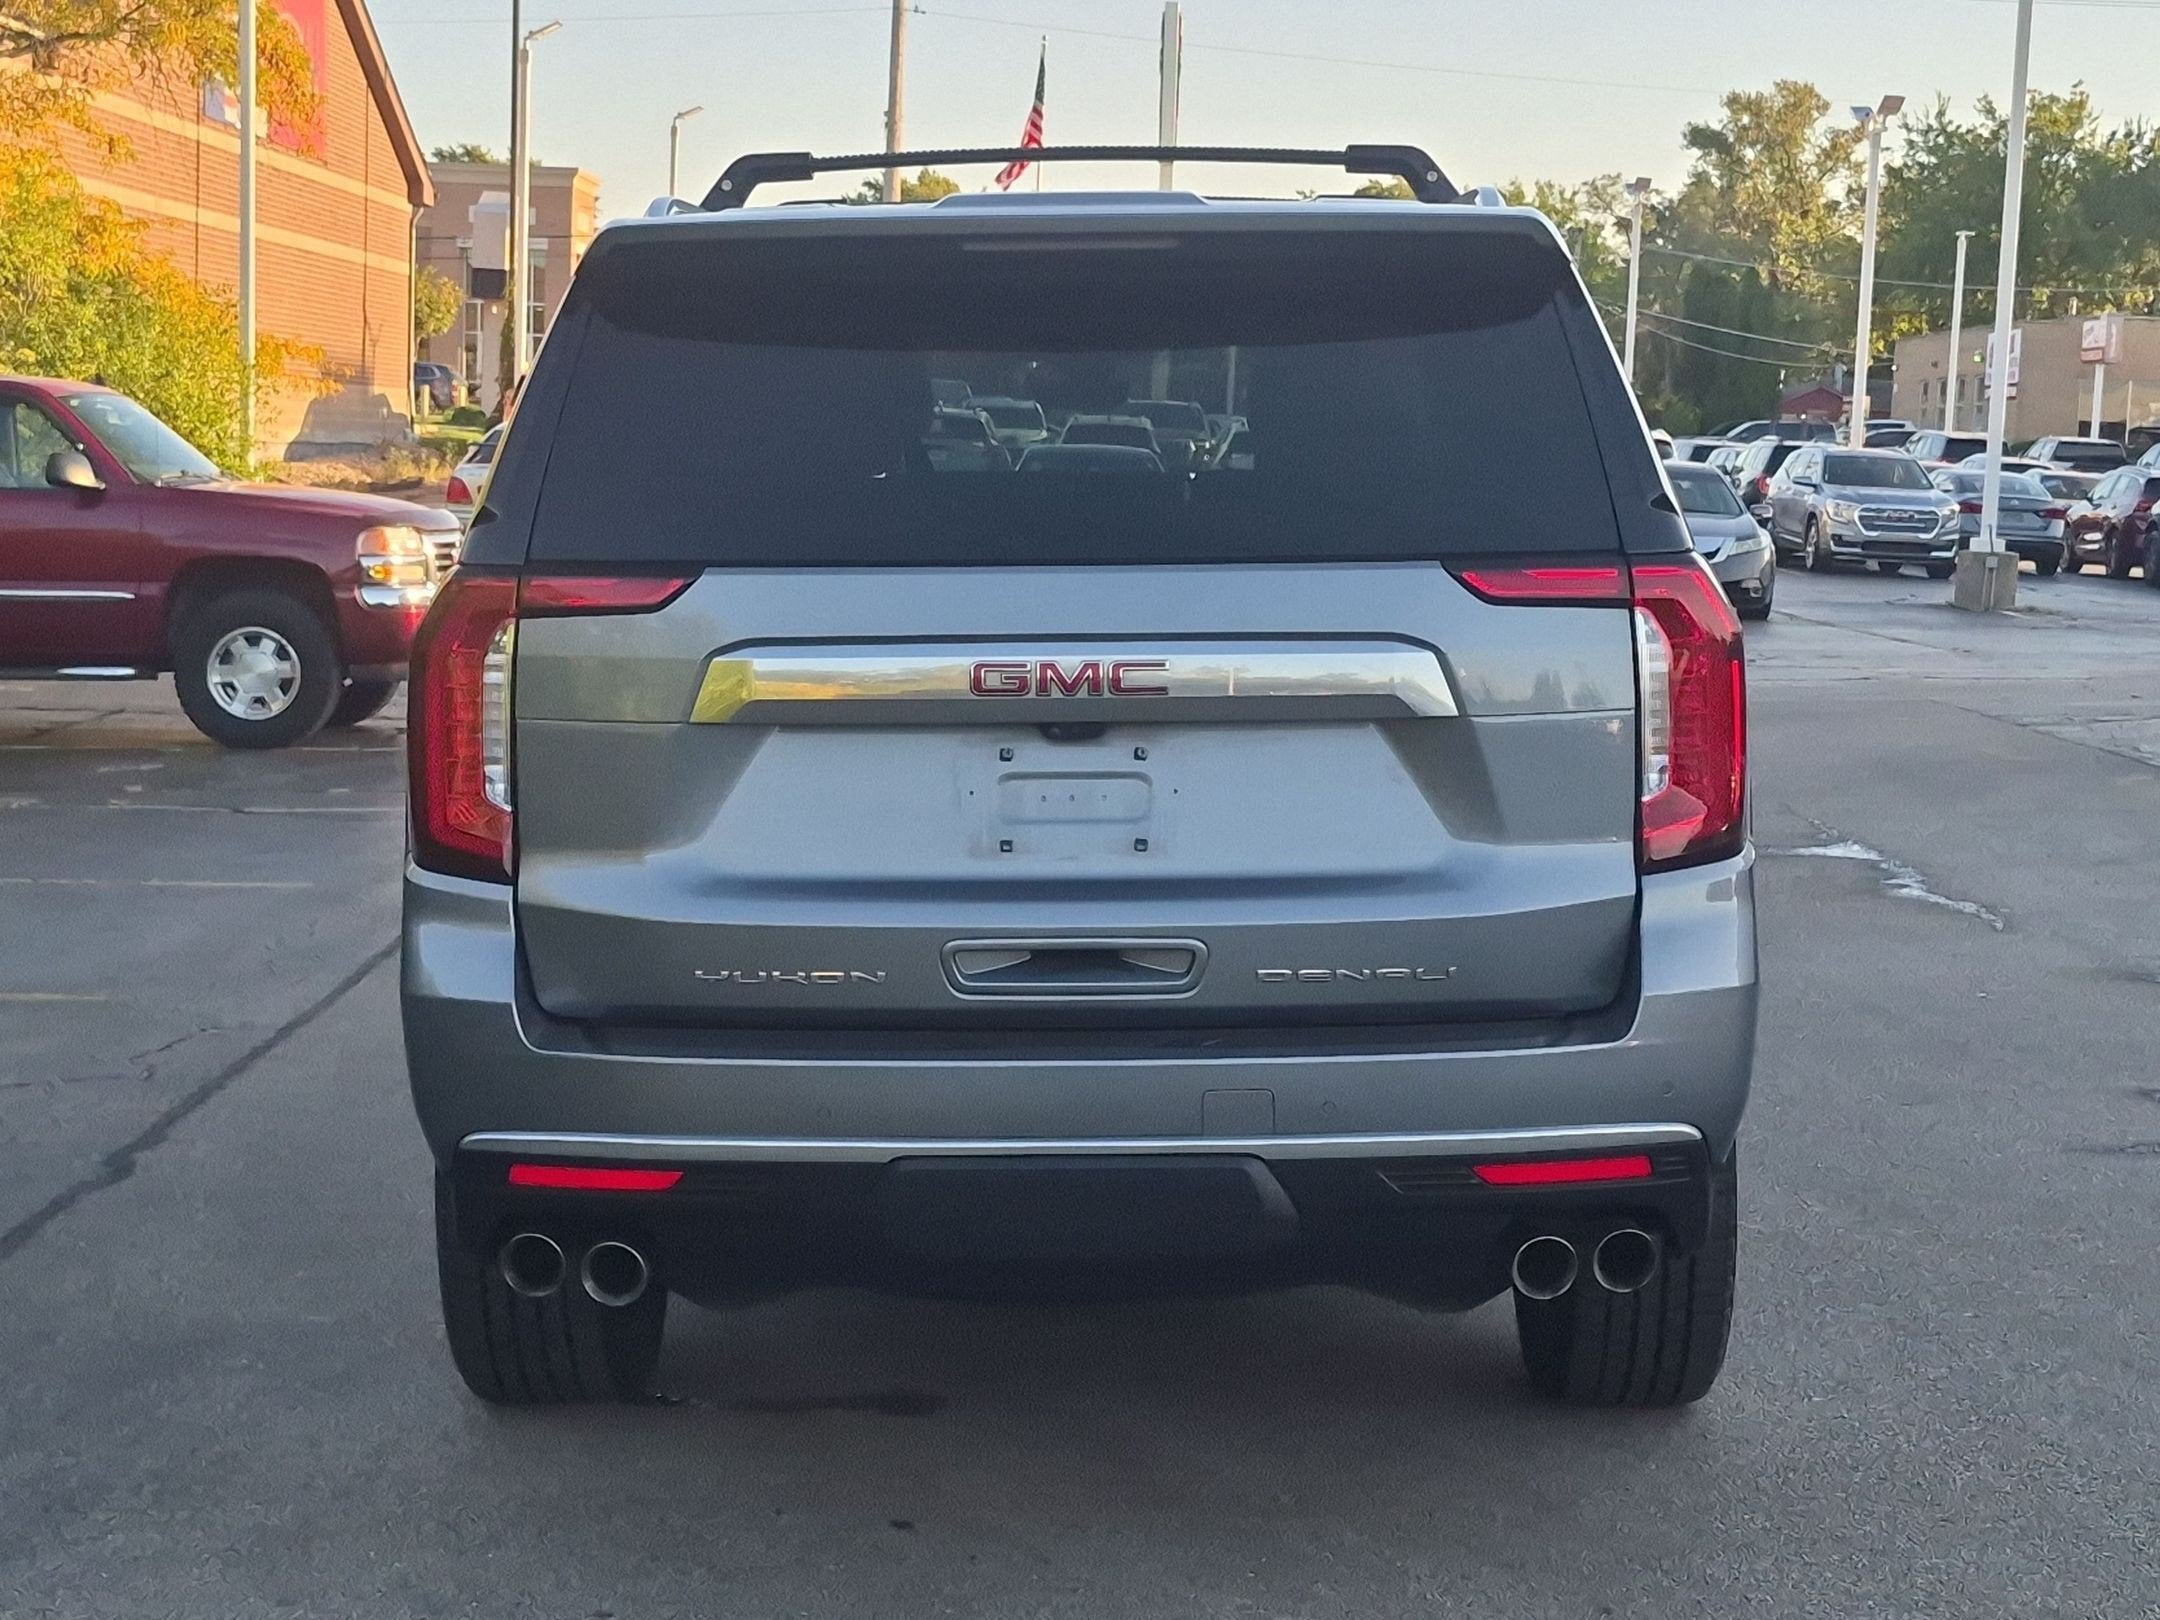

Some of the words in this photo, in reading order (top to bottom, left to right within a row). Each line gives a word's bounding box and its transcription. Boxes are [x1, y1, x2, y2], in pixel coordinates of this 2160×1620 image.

[969, 659, 1170, 697] GMC
[694, 969, 887, 985] YUKON
[1256, 965, 1458, 983] DENALI
